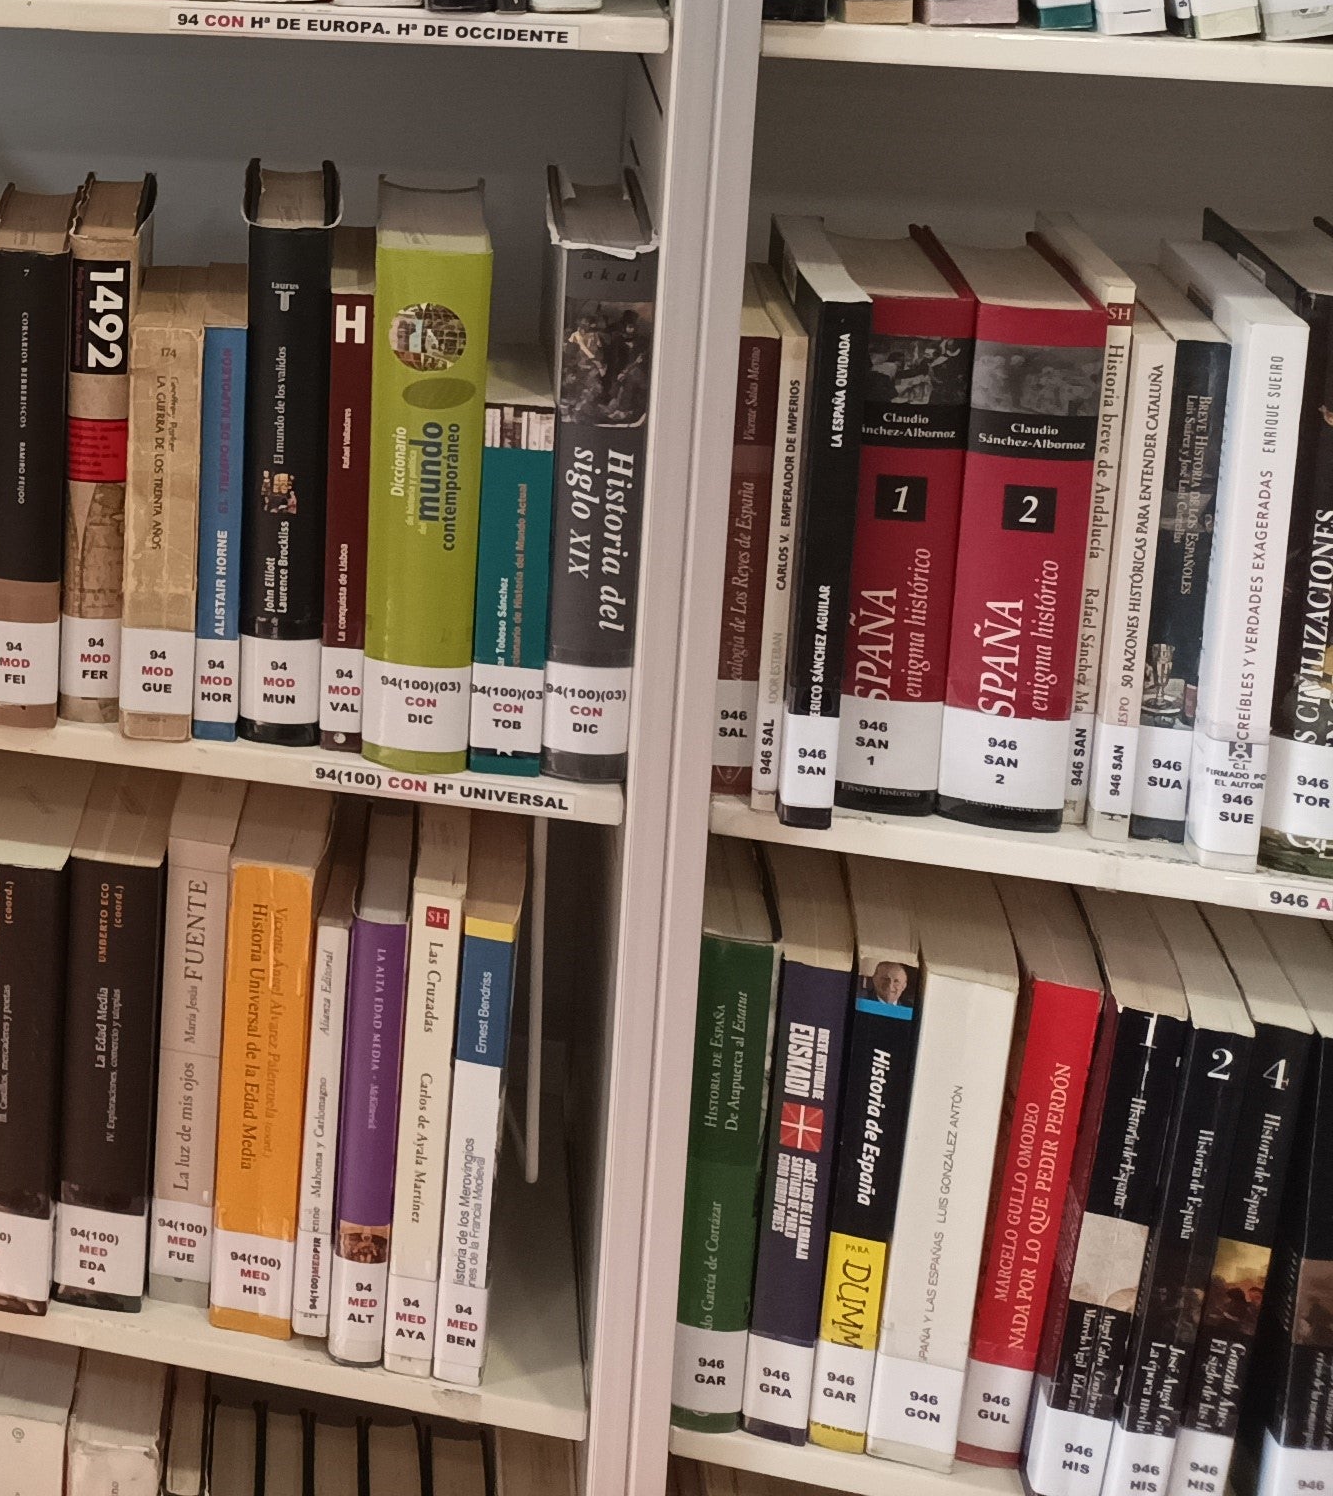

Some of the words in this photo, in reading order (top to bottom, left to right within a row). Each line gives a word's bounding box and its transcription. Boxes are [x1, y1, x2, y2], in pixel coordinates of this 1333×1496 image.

[177, 13, 199, 26] 94
[204, 14, 244, 28] CON
[277, 17, 302, 31] DE
[423, 24, 449, 38] DE
[455, 26, 568, 44] OCCIDENTE
[88, 268, 124, 369] 1492
[978, 433, 1086, 449] Sánchez-Albornoz
[1011, 423, 1059, 435] Claudio
[417, 422, 443, 523] mundo
[443, 423, 460, 551] contemporáneo
[565, 447, 596, 520] siglo
[602, 449, 635, 575] Historia
[567, 527, 592, 580] XIX
[599, 586, 624, 632] del
[315, 767, 382, 788] 94(100)
[388, 777, 427, 793] CON
[460, 785, 568, 810] UNIVERSAL
[184, 880, 207, 981] FUENTE
[428, 942, 444, 967] Las
[422, 970, 441, 1033] Cruzadas
[867, 1048, 891, 1118] Historia
[1045, 1063, 1072, 1134] PERDÓN
[866, 1120, 881, 1142] de
[857, 1143, 880, 1206] España
[1035, 1138, 1059, 1192] PEDIR
[347, 1297, 377, 1308] MED
[355, 1282, 372, 1293] 94
[347, 1313, 374, 1324] ALT
